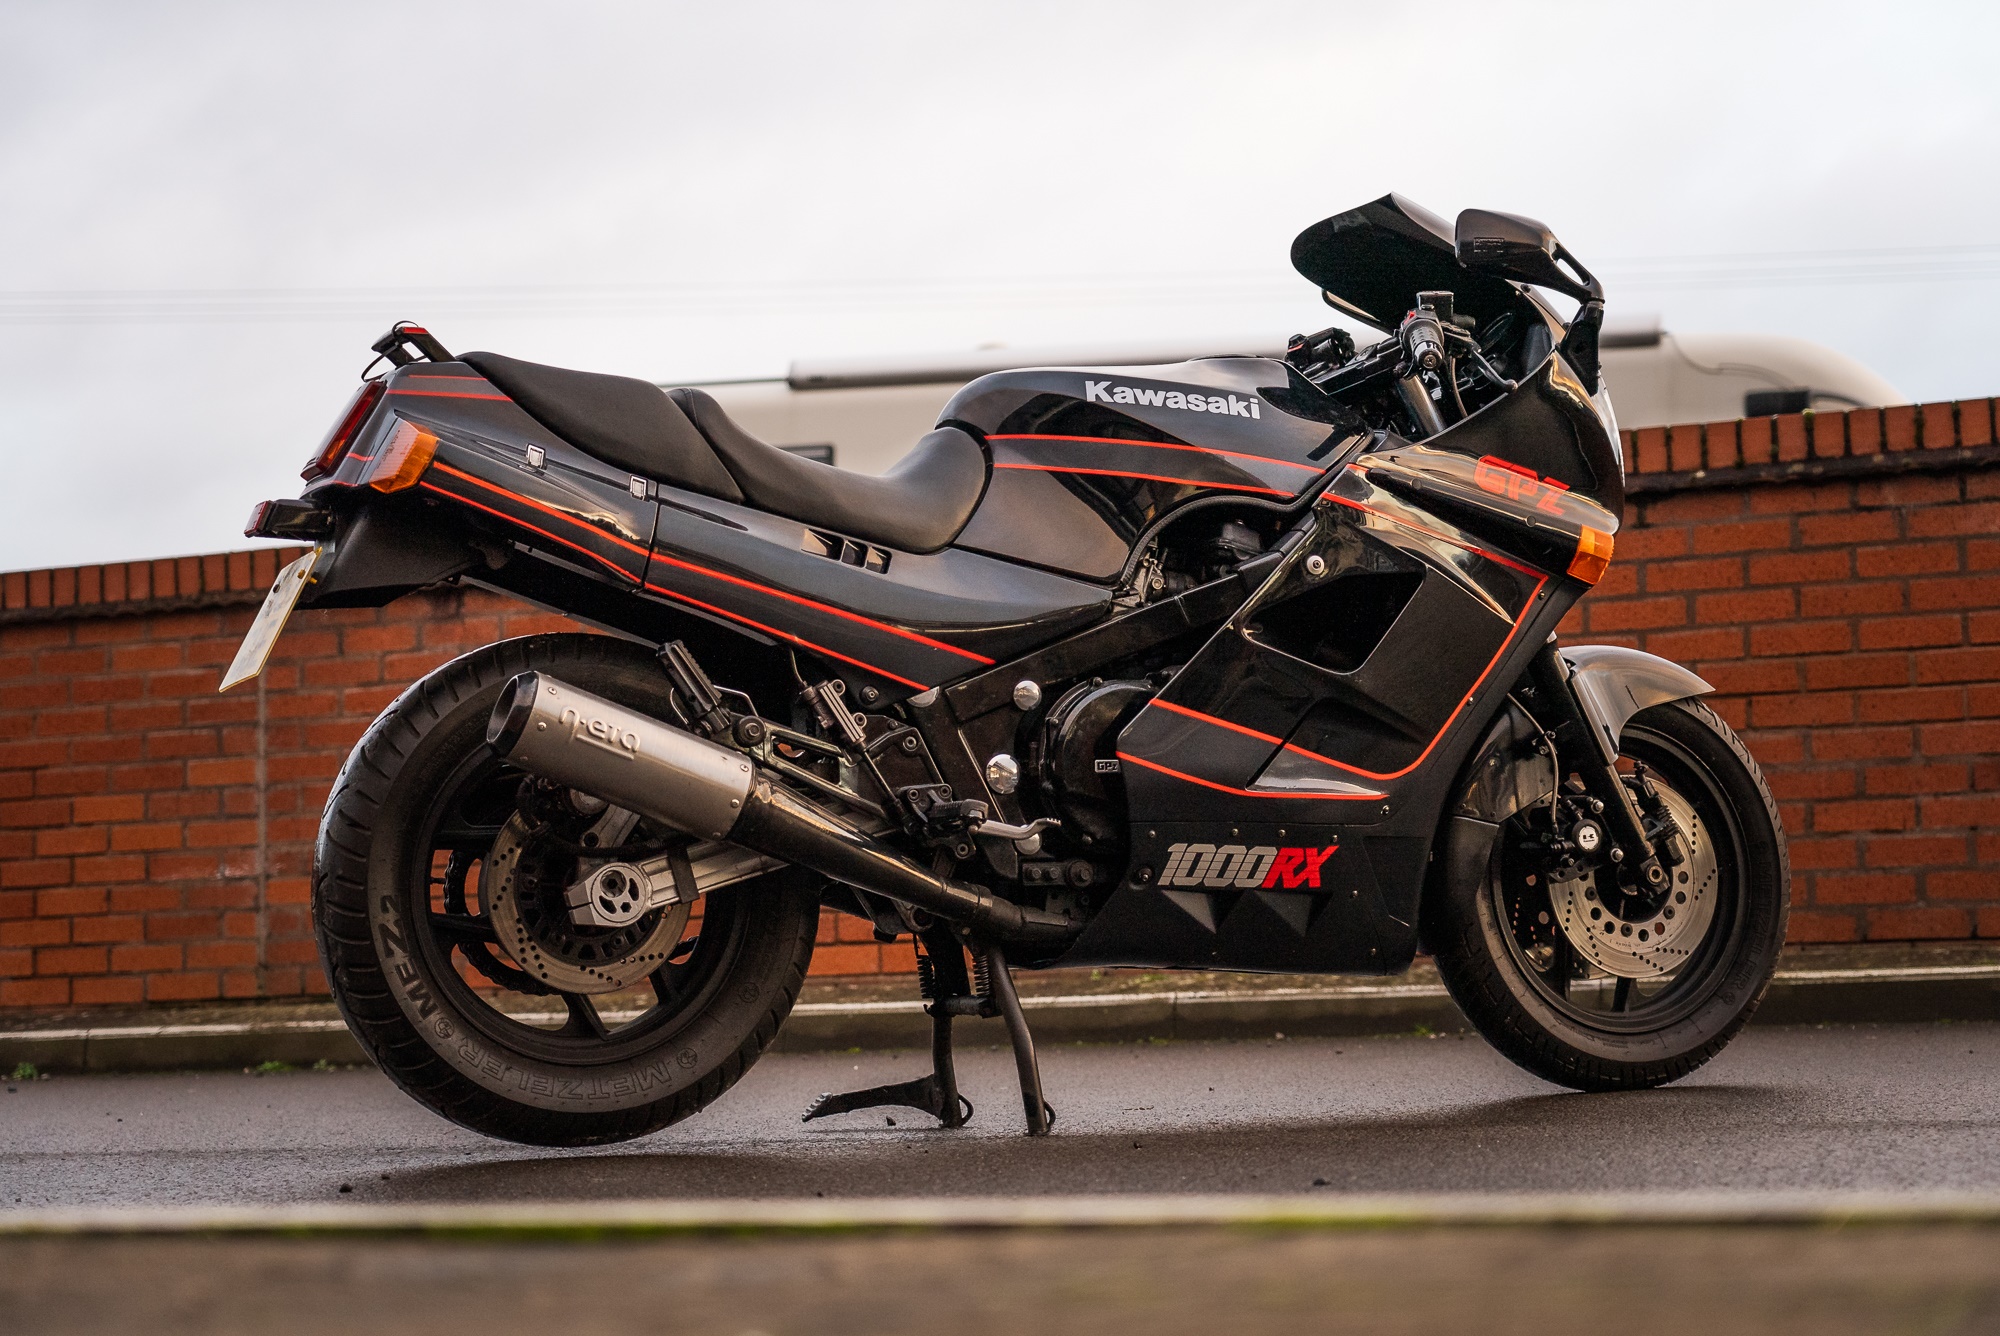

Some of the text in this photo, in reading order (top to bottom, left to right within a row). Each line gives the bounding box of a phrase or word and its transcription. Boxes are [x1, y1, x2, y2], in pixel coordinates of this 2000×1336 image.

[1085, 381, 1260, 419] Kawasaki
[1157, 843, 1340, 888] 1000RX
[458, 1037, 672, 1100] METZELER
